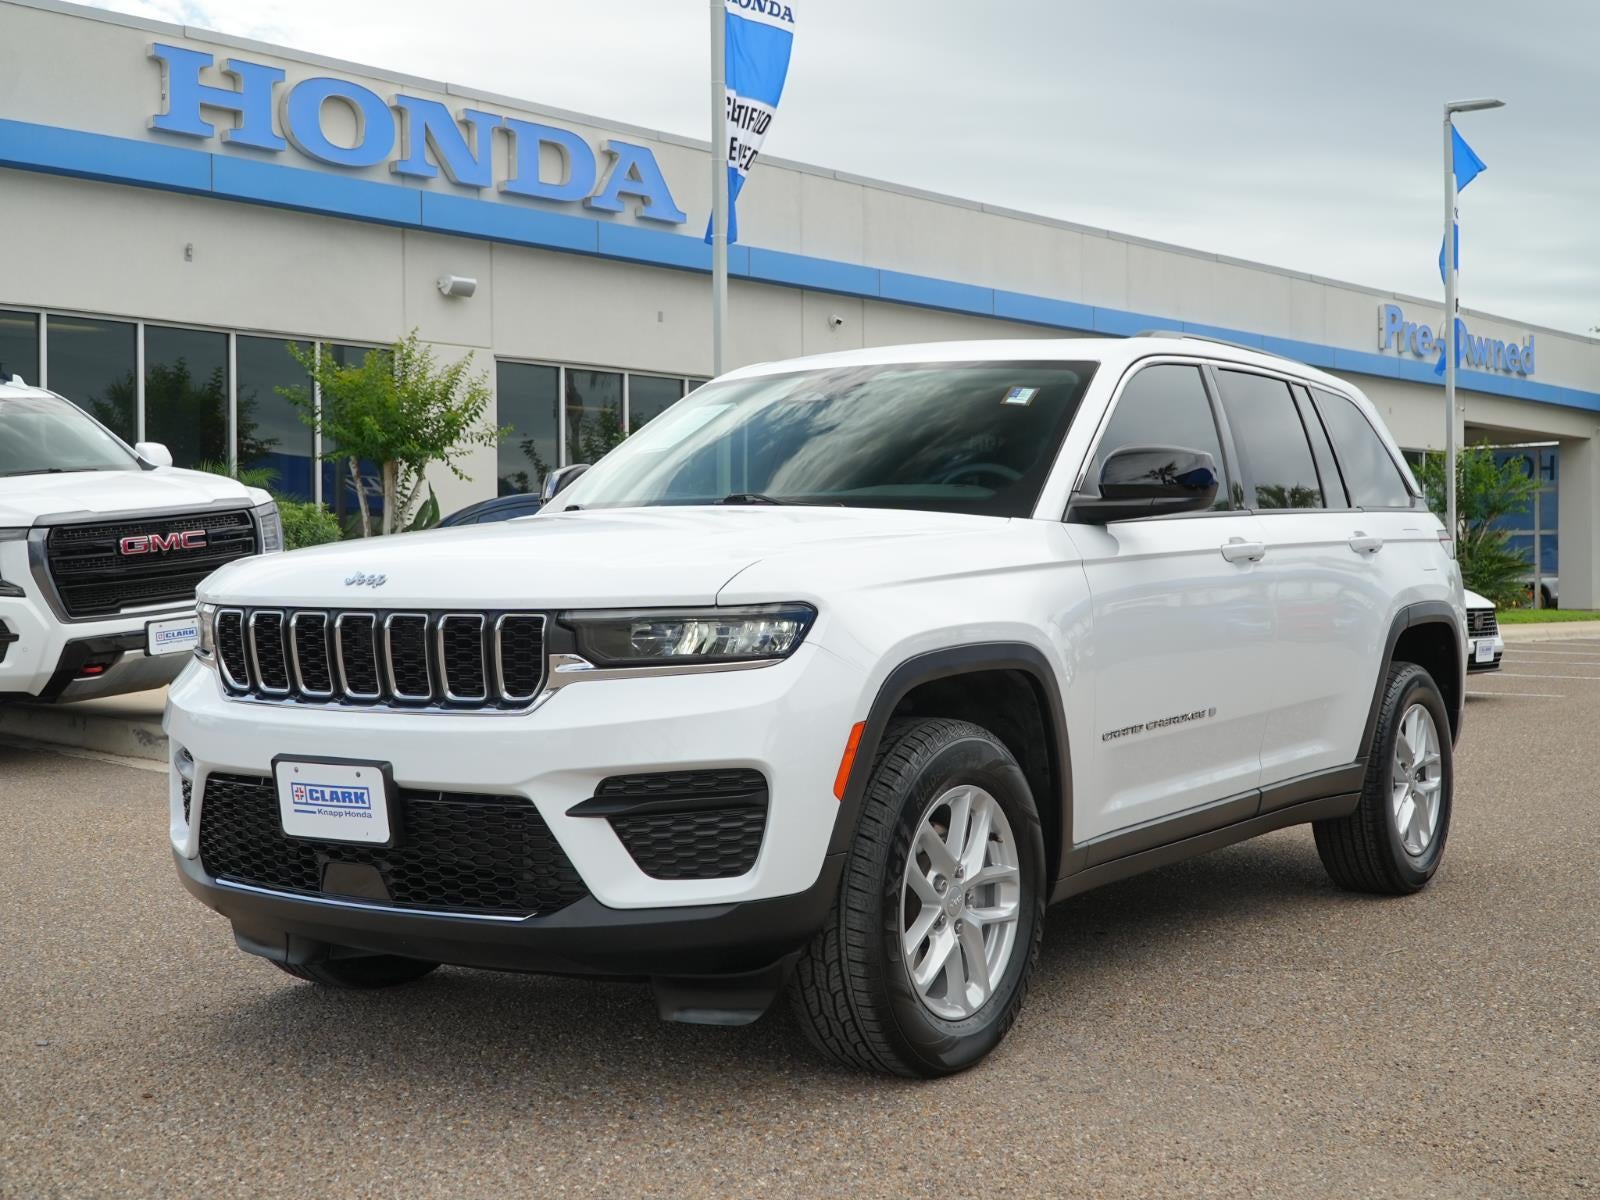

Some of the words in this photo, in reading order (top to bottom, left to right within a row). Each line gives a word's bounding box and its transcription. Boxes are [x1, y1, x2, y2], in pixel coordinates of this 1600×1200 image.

[727, 0, 795, 23] ONDA
[148, 42, 687, 225] HONDA
[120, 530, 207, 555] GMC
[344, 571, 388, 589] Jeep
[308, 788, 368, 805] CLARK
[317, 808, 344, 818] Knapp
[344, 810, 373, 819] Honda
